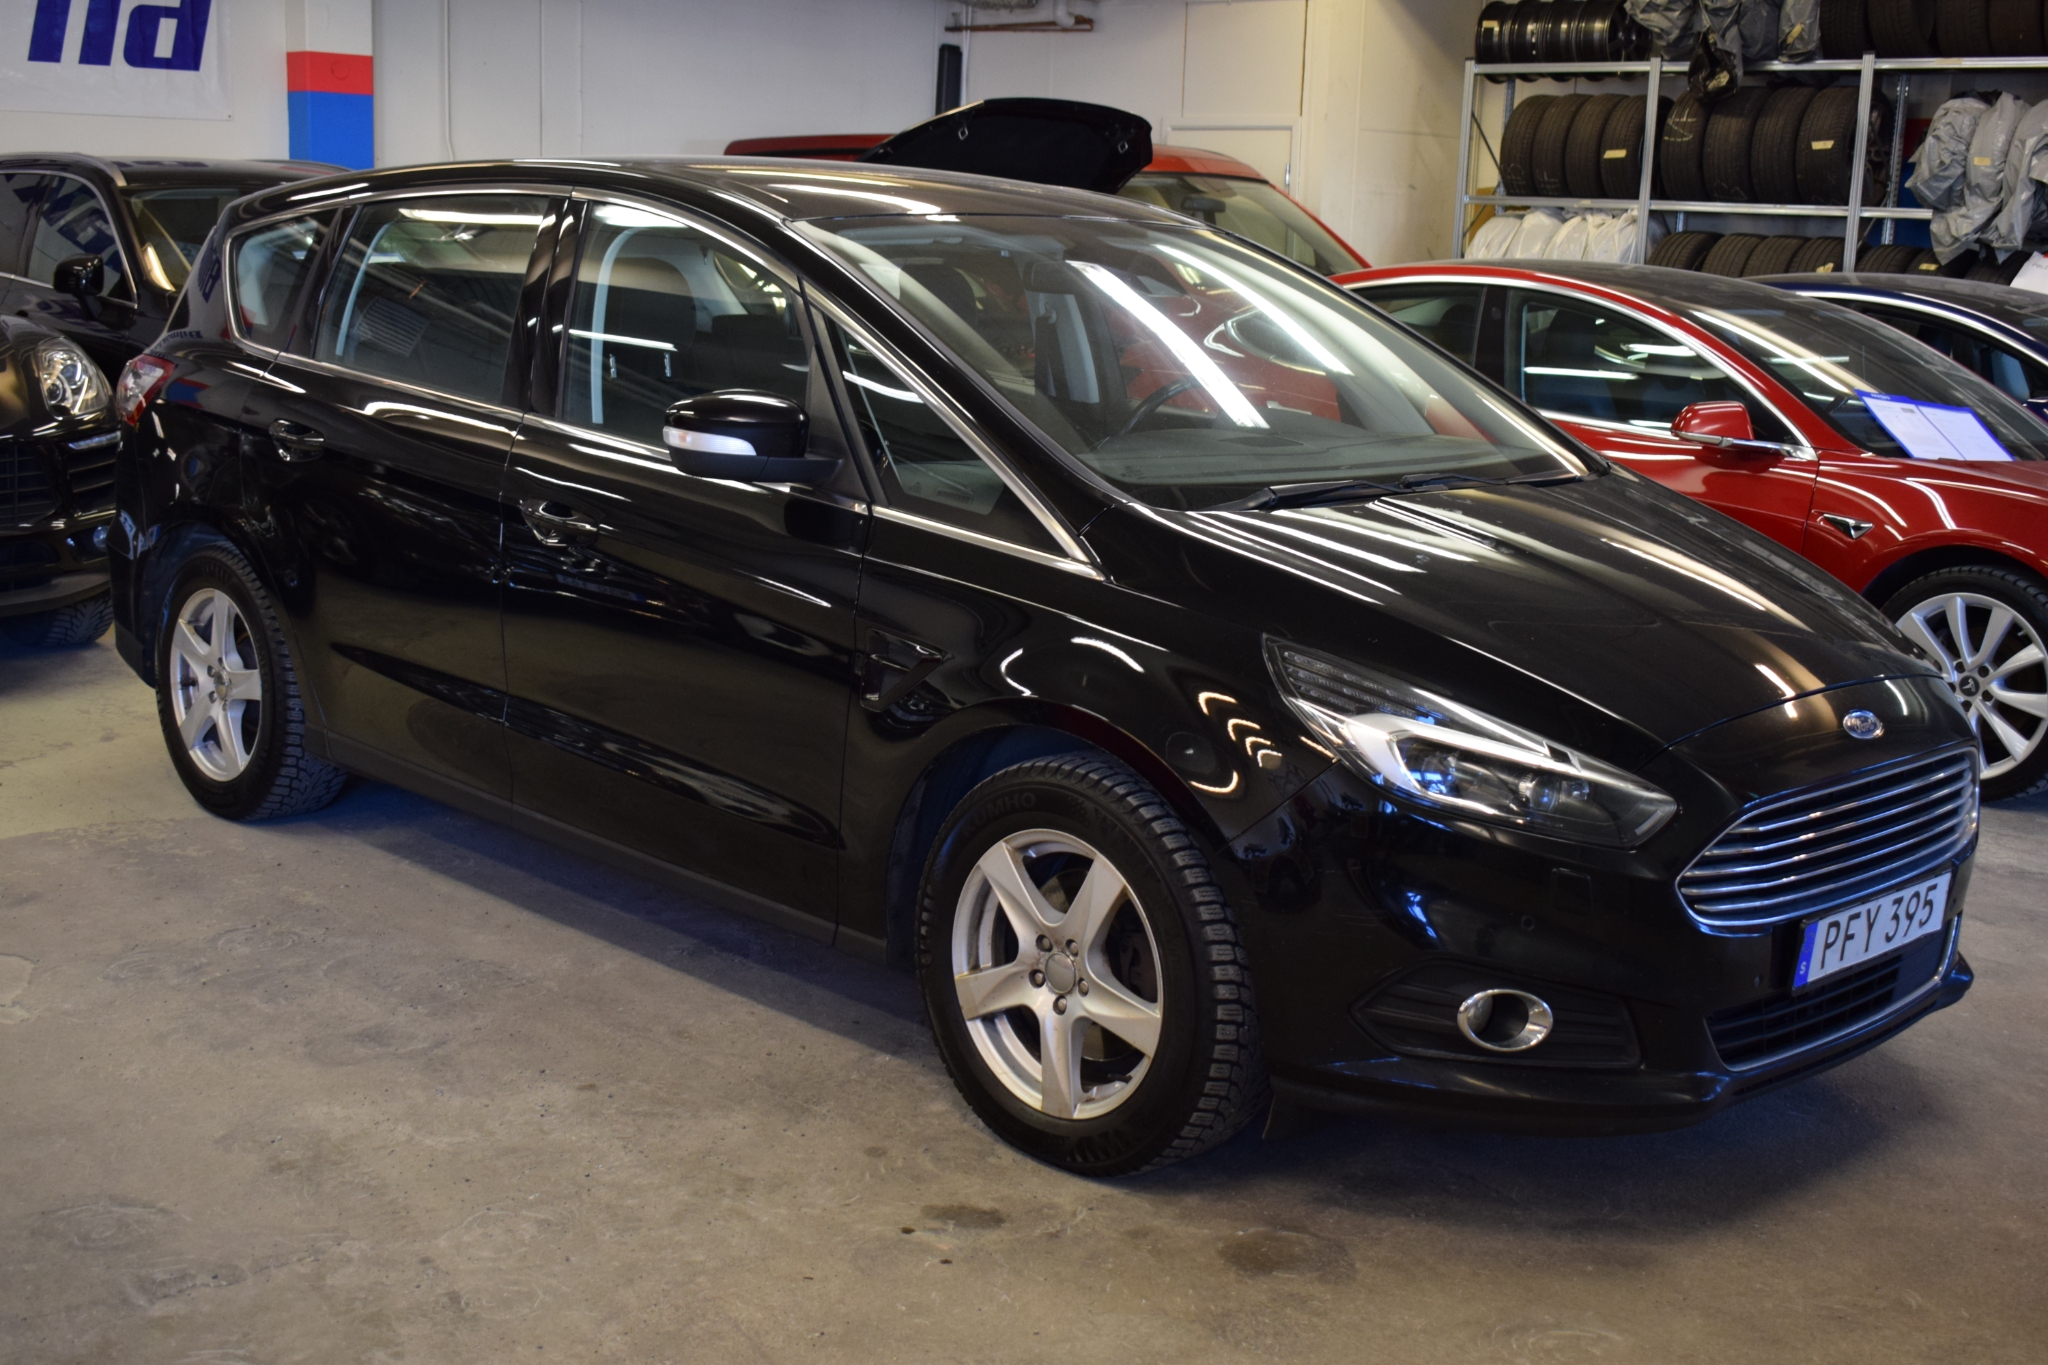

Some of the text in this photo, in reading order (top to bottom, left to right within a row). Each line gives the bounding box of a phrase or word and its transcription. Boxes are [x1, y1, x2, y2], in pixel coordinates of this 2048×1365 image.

[963, 792, 1036, 837] KUMHO
[1820, 883, 1938, 969] PFY 395
[1799, 961, 1807, 975] S
